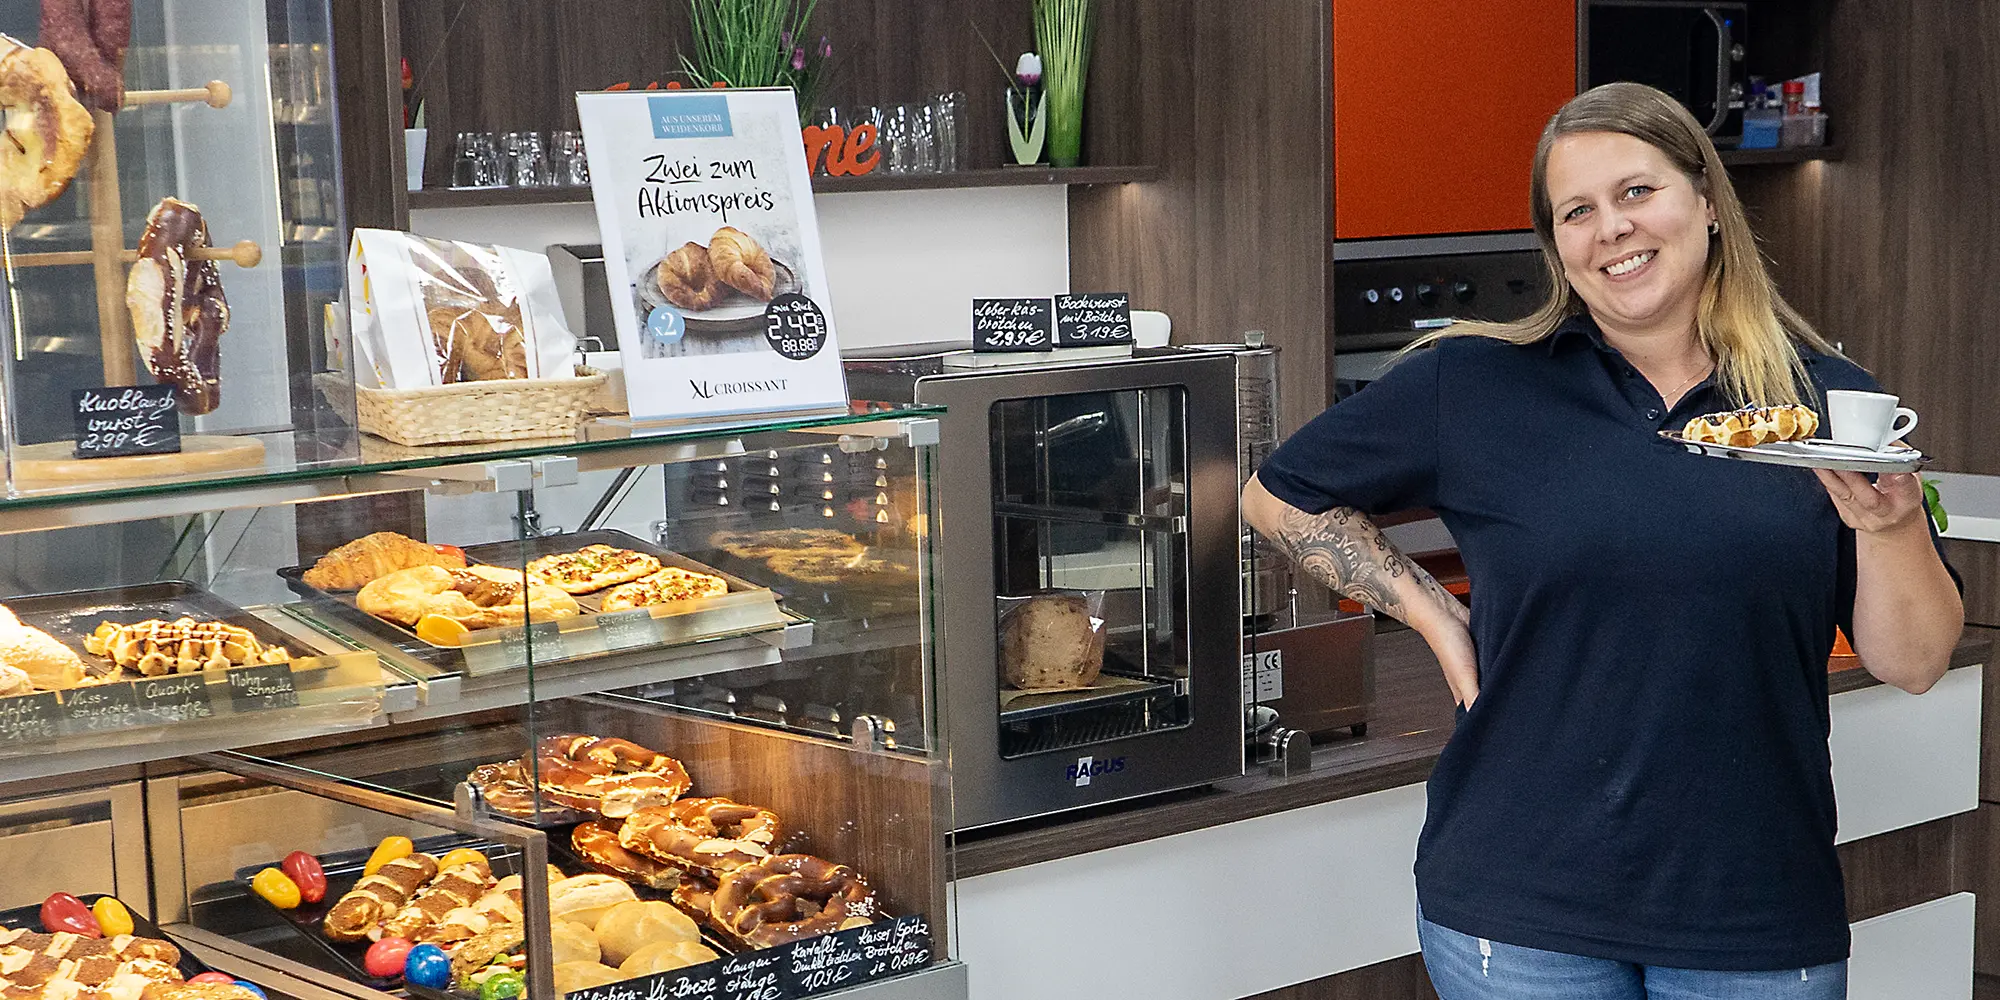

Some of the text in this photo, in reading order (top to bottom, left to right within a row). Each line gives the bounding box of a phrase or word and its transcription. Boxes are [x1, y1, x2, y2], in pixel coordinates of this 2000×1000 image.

[660, 113, 722, 124] AUS UNSEREM
[661, 123, 724, 134] WEIDENKORB
[643, 154, 757, 184] Zwei zum
[637, 186, 775, 223] Aktionspreis
[1058, 294, 1128, 310] Bockwurst
